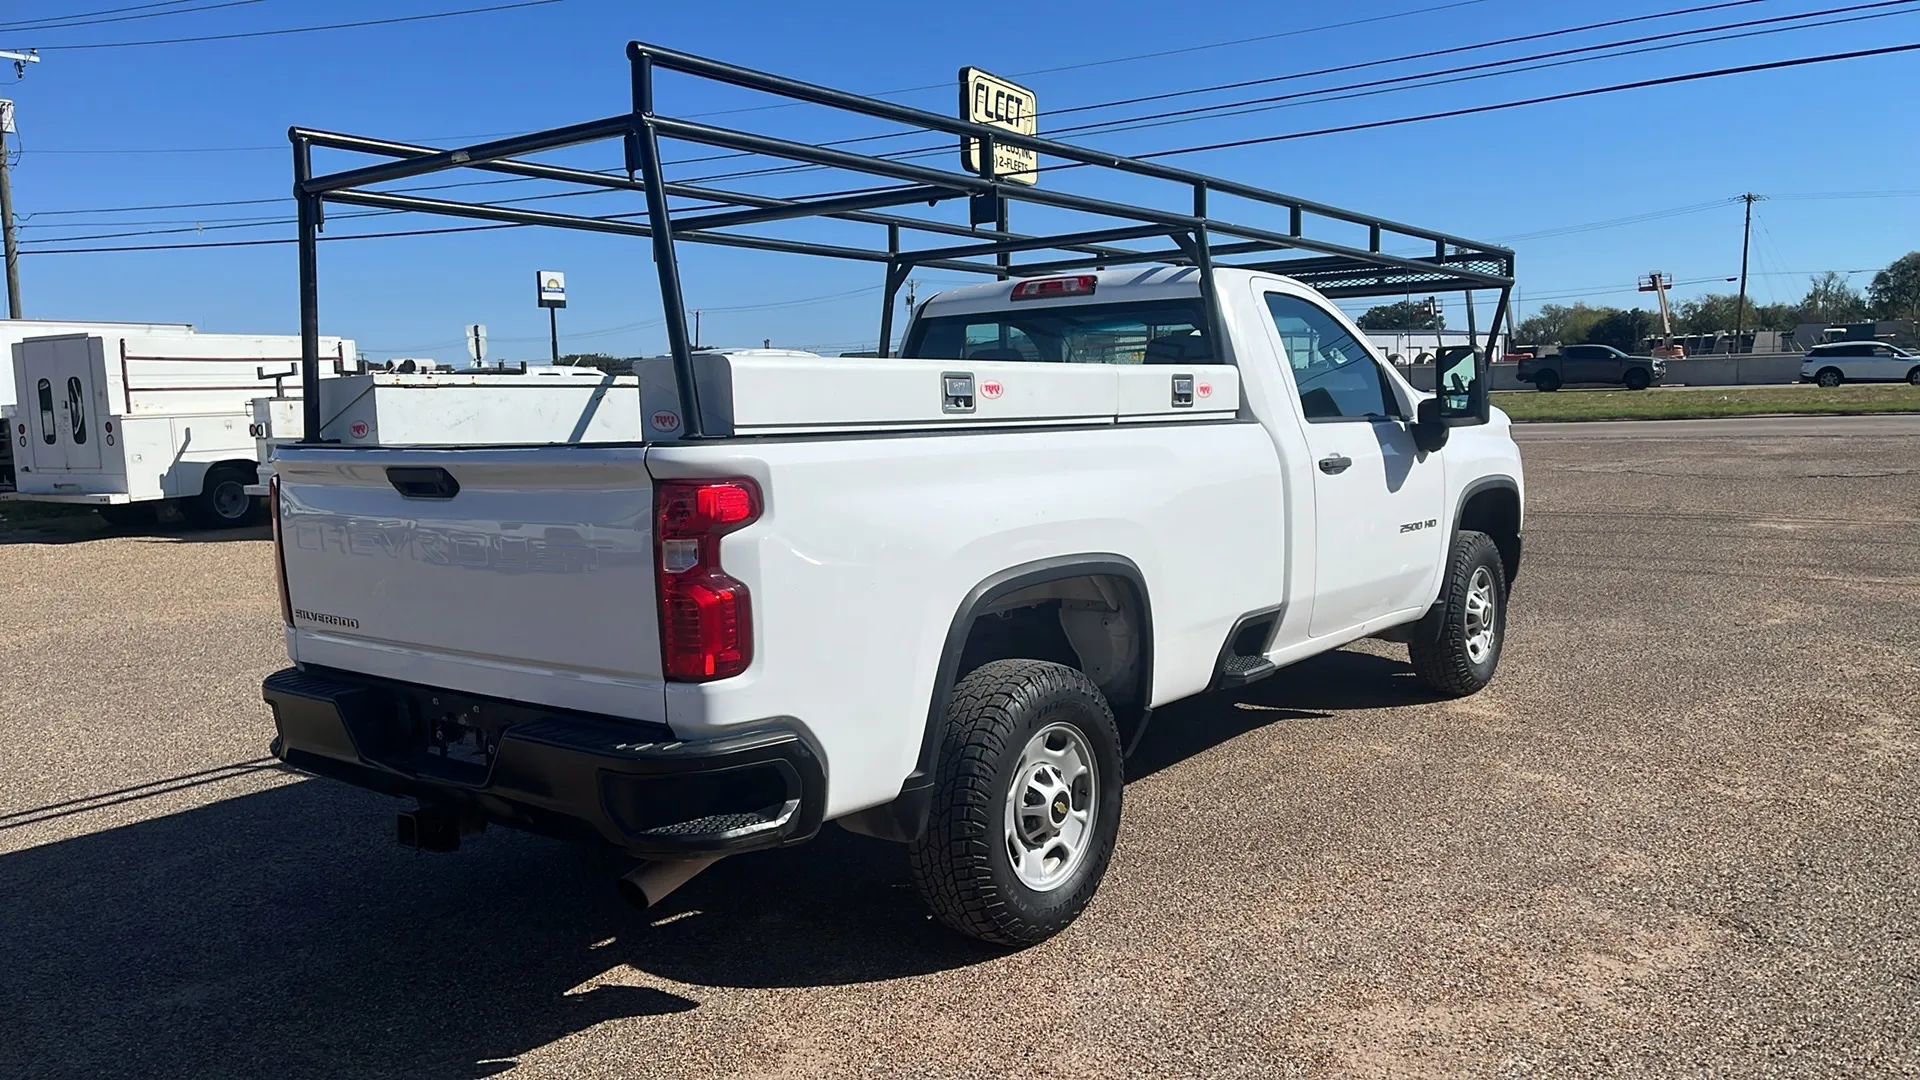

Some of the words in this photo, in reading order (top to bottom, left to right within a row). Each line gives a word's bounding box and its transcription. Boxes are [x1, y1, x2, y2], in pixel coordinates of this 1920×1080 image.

[1400, 521, 1423, 533] 2500
[1424, 519, 1437, 528] HD
[295, 609, 360, 629] SILVERADO
